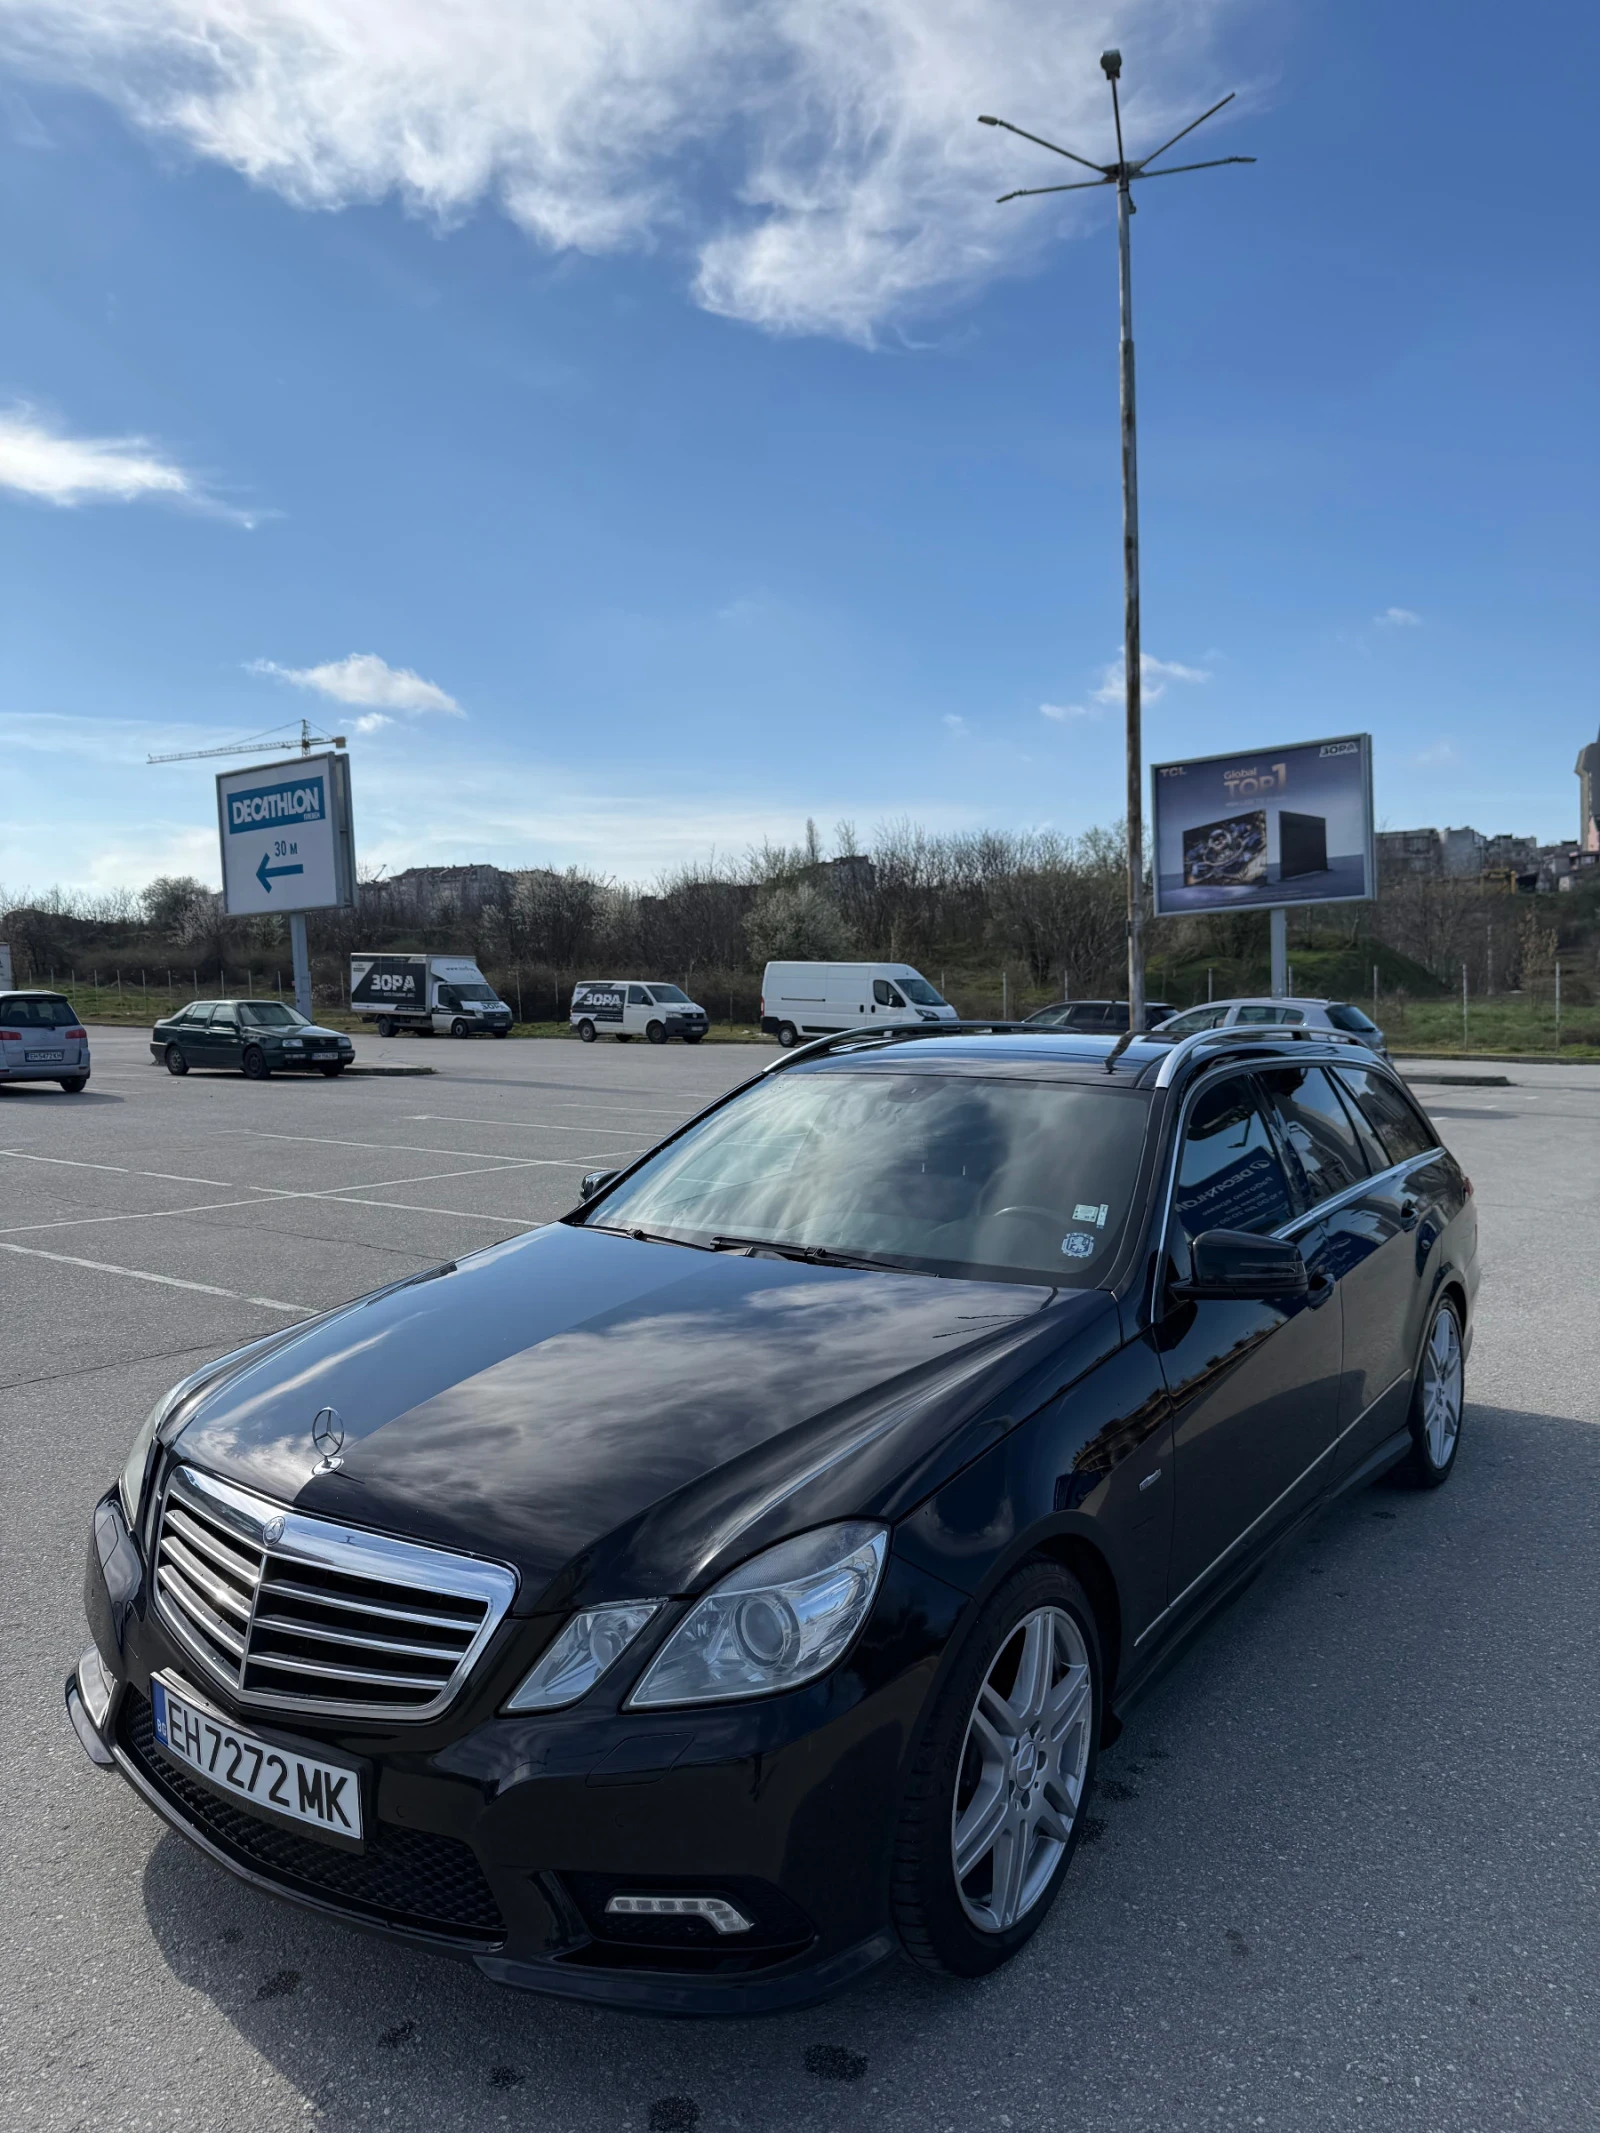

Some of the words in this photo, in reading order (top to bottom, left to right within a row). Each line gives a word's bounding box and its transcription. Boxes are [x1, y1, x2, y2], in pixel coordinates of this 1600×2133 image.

[1159, 766, 1187, 777] TCL
[1223, 767, 1257, 781] Global
[232, 787, 320, 825] DECATHLON
[274, 840, 286, 857] 30
[370, 974, 416, 992] ЗОРА
[584, 993, 622, 1006] ЗОРА
[156, 1718, 167, 1737] BG
